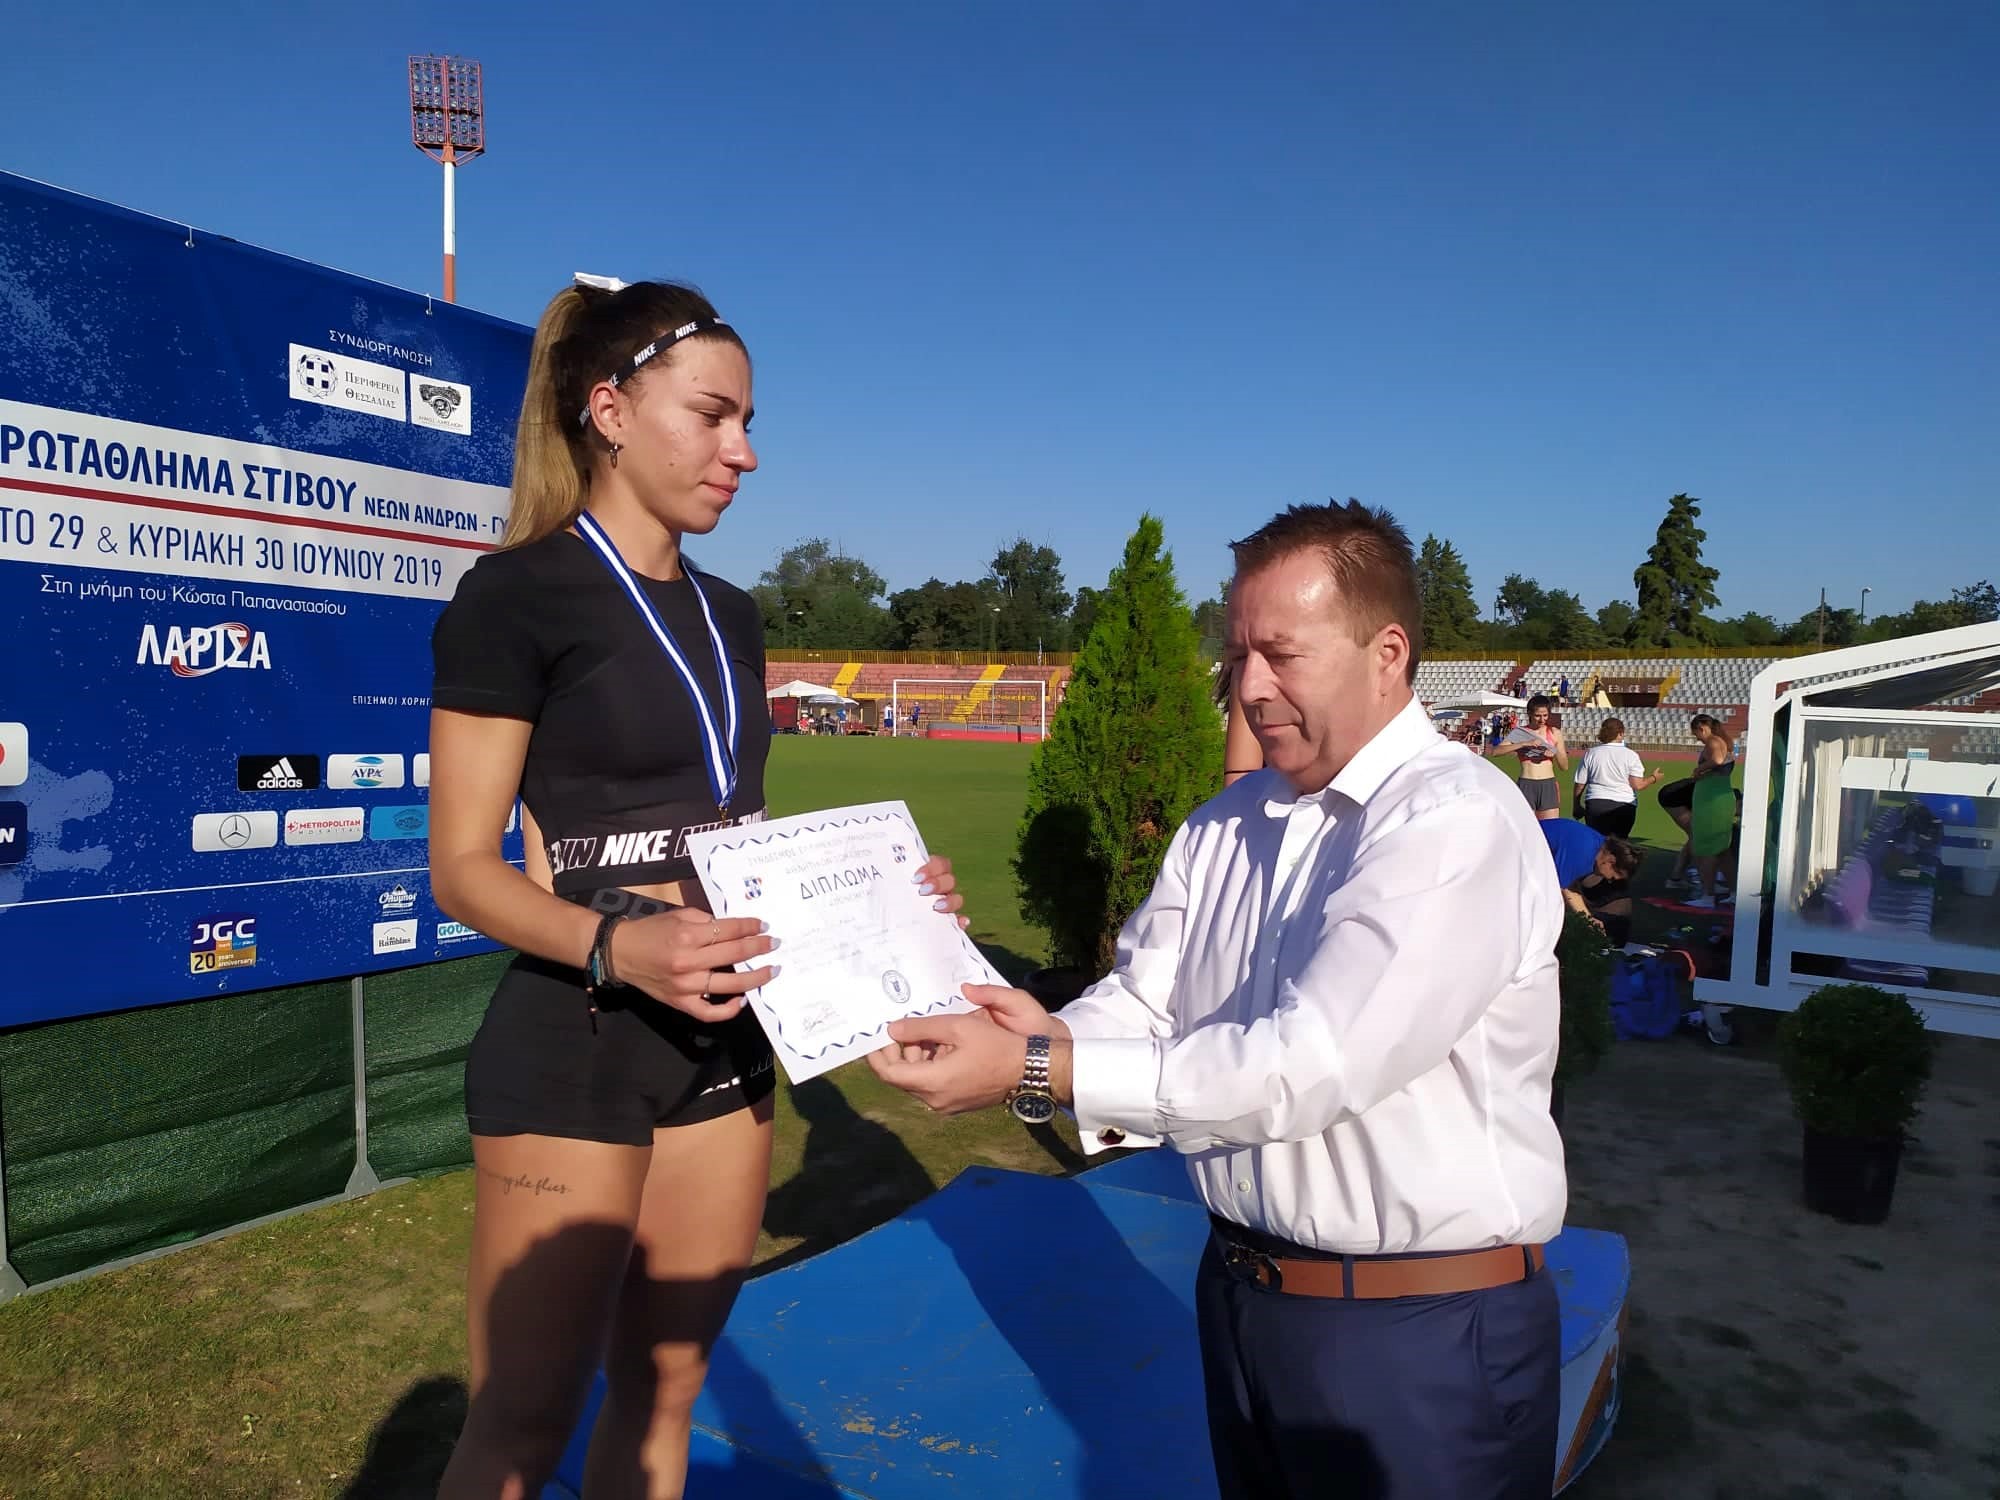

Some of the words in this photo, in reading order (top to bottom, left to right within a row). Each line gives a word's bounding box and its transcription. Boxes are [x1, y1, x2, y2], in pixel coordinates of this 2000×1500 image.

[674, 320, 699, 339] NIKE
[329, 330, 433, 367] ΣΥΝΔΙΟΡΓΑΝΩΣΗ
[633, 342, 657, 366] NIKE
[0, 424, 235, 496] ΡΩΤΑΘΛΗΜΑ
[242, 463, 357, 513] ΣΤΙΒΟΥ
[364, 496, 410, 521] ΝΕΩΝ
[414, 504, 478, 532] ΑΝΔΡΩΝ
[0, 507, 35, 546] ΤΟ
[49, 512, 84, 550] 29
[97, 526, 118, 554] &
[129, 522, 244, 567] ΚΥΡΙΑΚΗ
[255, 537, 284, 570] 30
[293, 542, 385, 581] ΙΟΥΝΙΟΥ
[393, 554, 442, 587] 2019
[40, 574, 73, 594] Στη
[80, 580, 133, 602] μνήμη
[139, 586, 166, 601] του
[172, 586, 226, 606] Κώστα
[231, 591, 346, 615] Παπαναστασίου
[136, 623, 272, 670] ΛΑΡΙΣΑ
[352, 695, 398, 705] ΕΠΙΣΗΜΟΙ
[400, 696, 432, 707] ΧΟΡΗΓ
[257, 776, 303, 789] adidas
[300, 819, 361, 830] METROPOLITAN
[598, 829, 673, 868] NIKE
[800, 864, 883, 900] ΔΙΠΛΩΜΑ
[192, 918, 256, 945] JGC
[193, 952, 216, 972] 20
